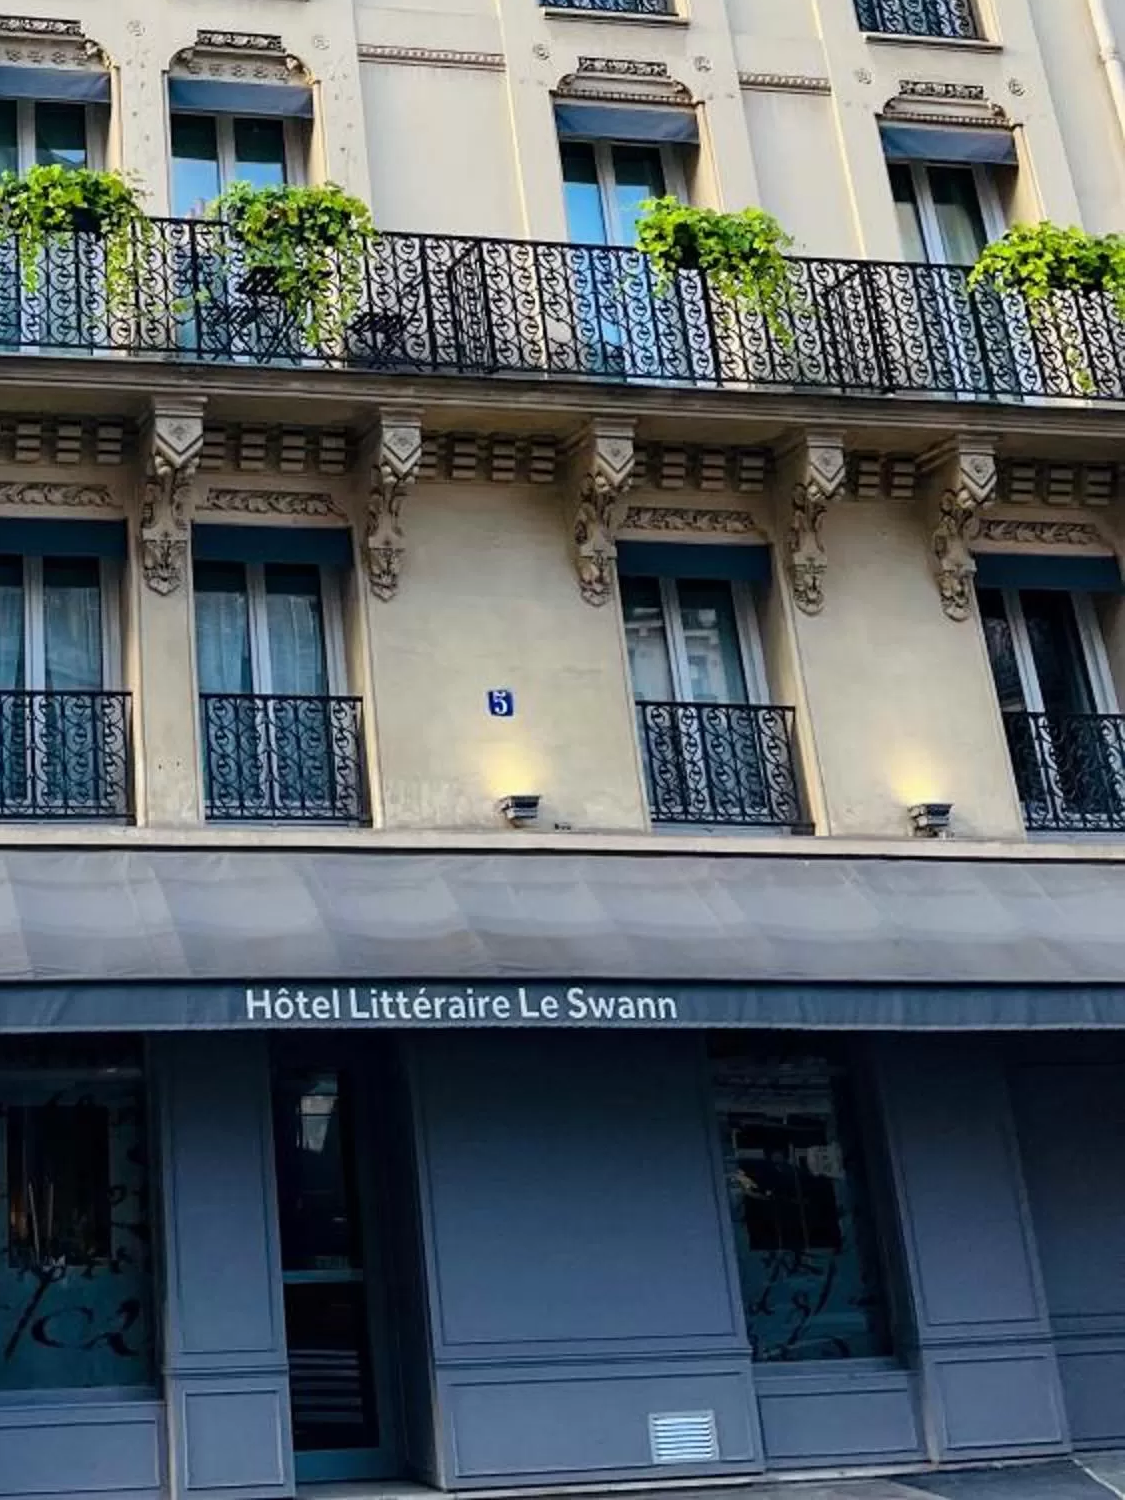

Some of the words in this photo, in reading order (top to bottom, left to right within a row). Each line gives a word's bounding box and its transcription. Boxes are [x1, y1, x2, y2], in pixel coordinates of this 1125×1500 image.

[493, 690, 508, 715] 5
[246, 988, 341, 1020] Hôtel
[349, 988, 510, 1020] Littéraire
[518, 987, 560, 1020] Le
[567, 988, 679, 1020] Swann
